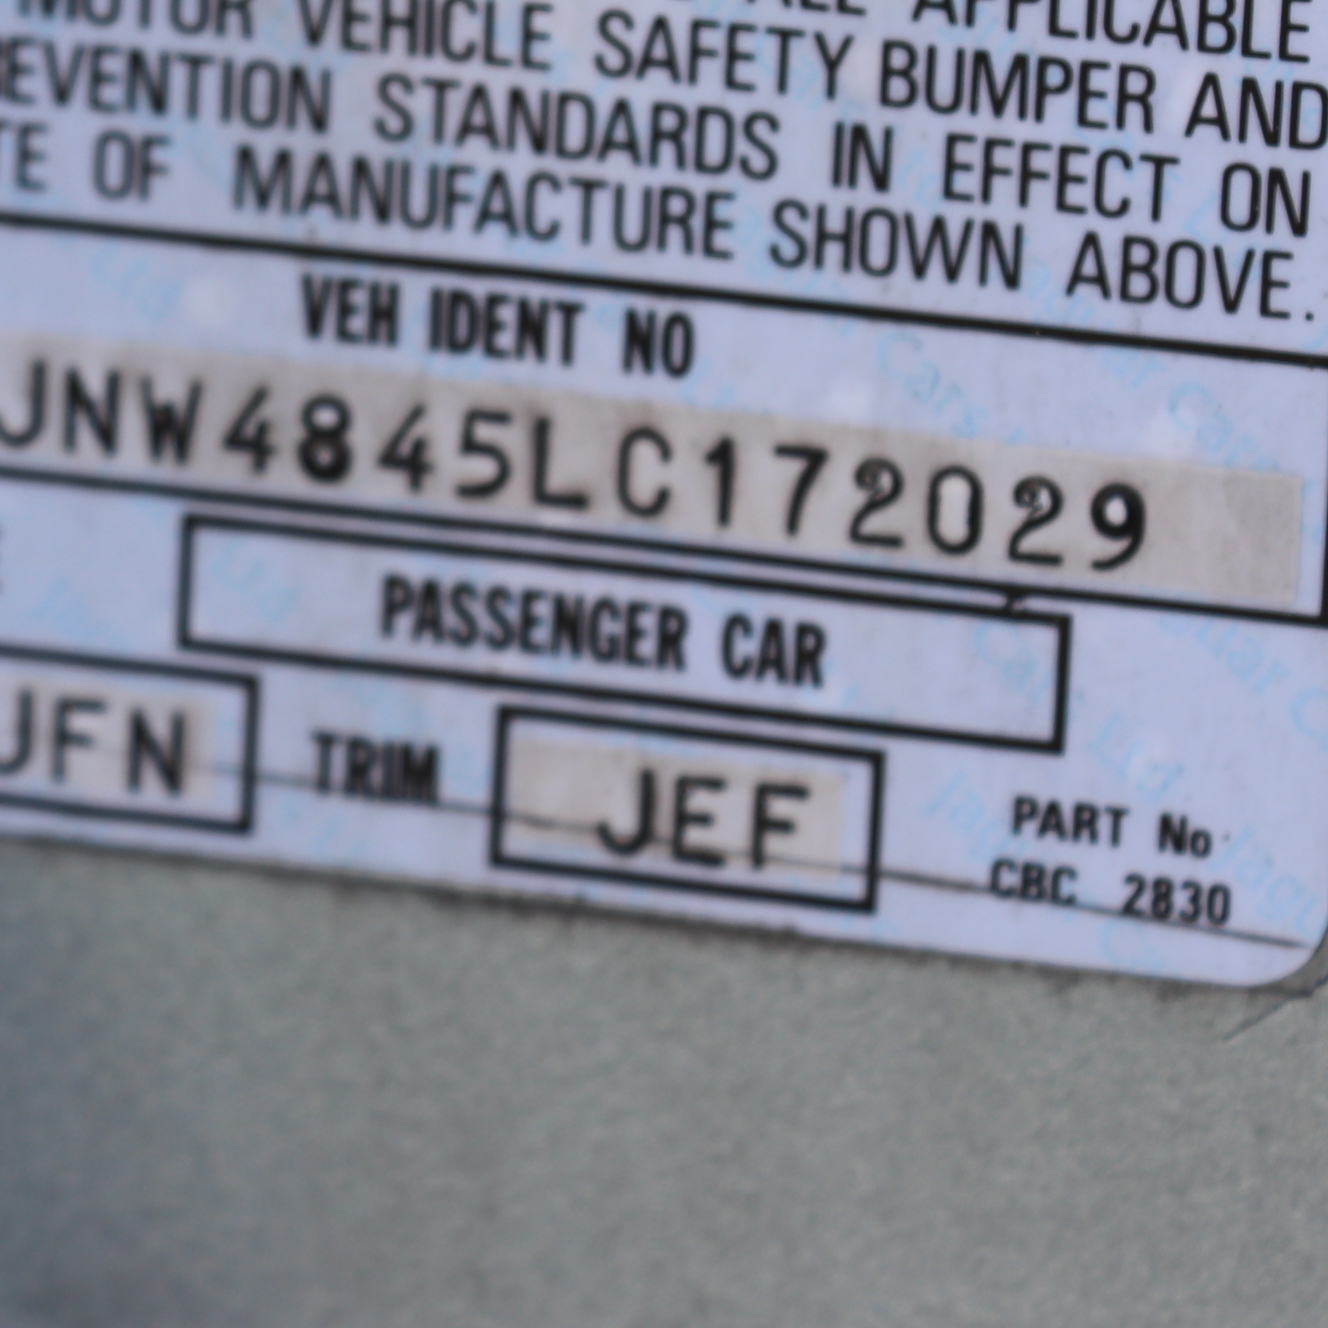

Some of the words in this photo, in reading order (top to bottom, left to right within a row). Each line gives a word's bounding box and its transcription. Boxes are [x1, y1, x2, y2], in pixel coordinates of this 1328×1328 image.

[594, 10, 852, 101] SAFETY
[880, 39, 1157, 134] BUMPER
[373, 74, 780, 180] STANDARDS
[832, 123, 893, 193] IN
[943, 134, 1181, 223] EFFECT
[1220, 162, 1311, 238] ON
[95, 129, 171, 201] OF
[232, 145, 735, 260] MANUFACTURE
[769, 199, 1025, 290] SHOWN
[1068, 234, 1315, 324] ABOVE.
[301, 275, 399, 349] VEH
[430, 288, 584, 371] IDENT
[624, 310, 695, 379] NO
[379, 574, 687, 671] PASSENGER
[722, 615, 826, 688] CAR
[311, 731, 440, 806] TRIM
[598, 769, 809, 870] JEF
[1012, 795, 1129, 847] PART
[990, 859, 1077, 907] CBC
[1123, 875, 1232, 926] 2830
